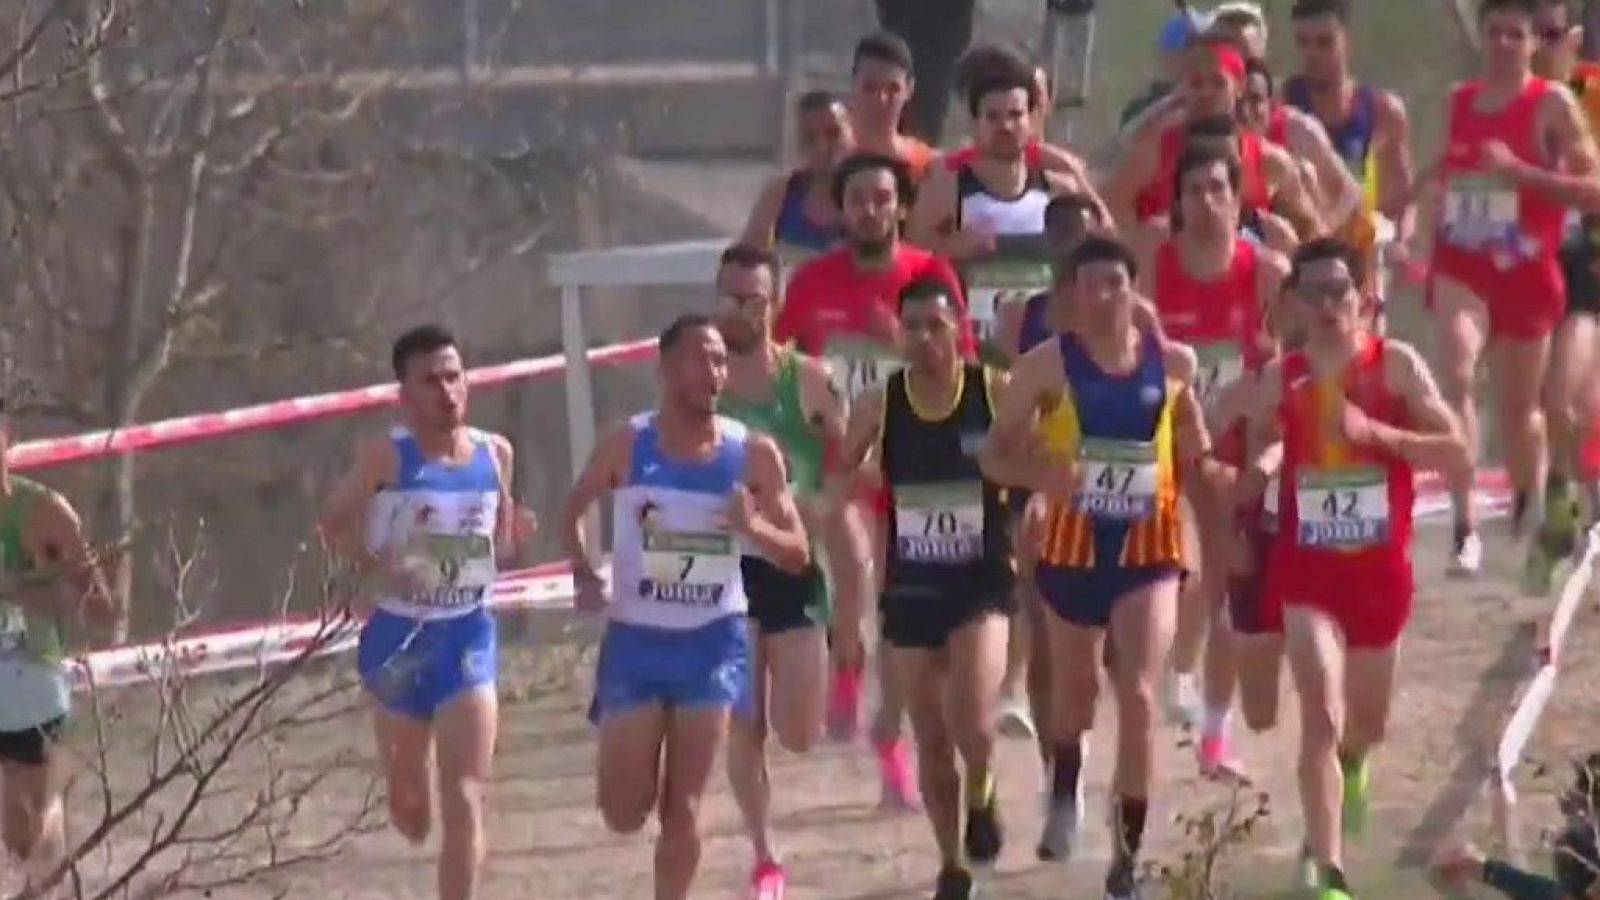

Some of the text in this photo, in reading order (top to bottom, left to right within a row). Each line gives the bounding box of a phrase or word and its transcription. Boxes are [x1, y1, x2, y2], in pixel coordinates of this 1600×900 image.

[1096, 466, 1135, 494] 47
[1321, 491, 1359, 518] 42
[921, 511, 957, 537] 70
[439, 558, 459, 585] 9
[678, 555, 695, 581] 7
